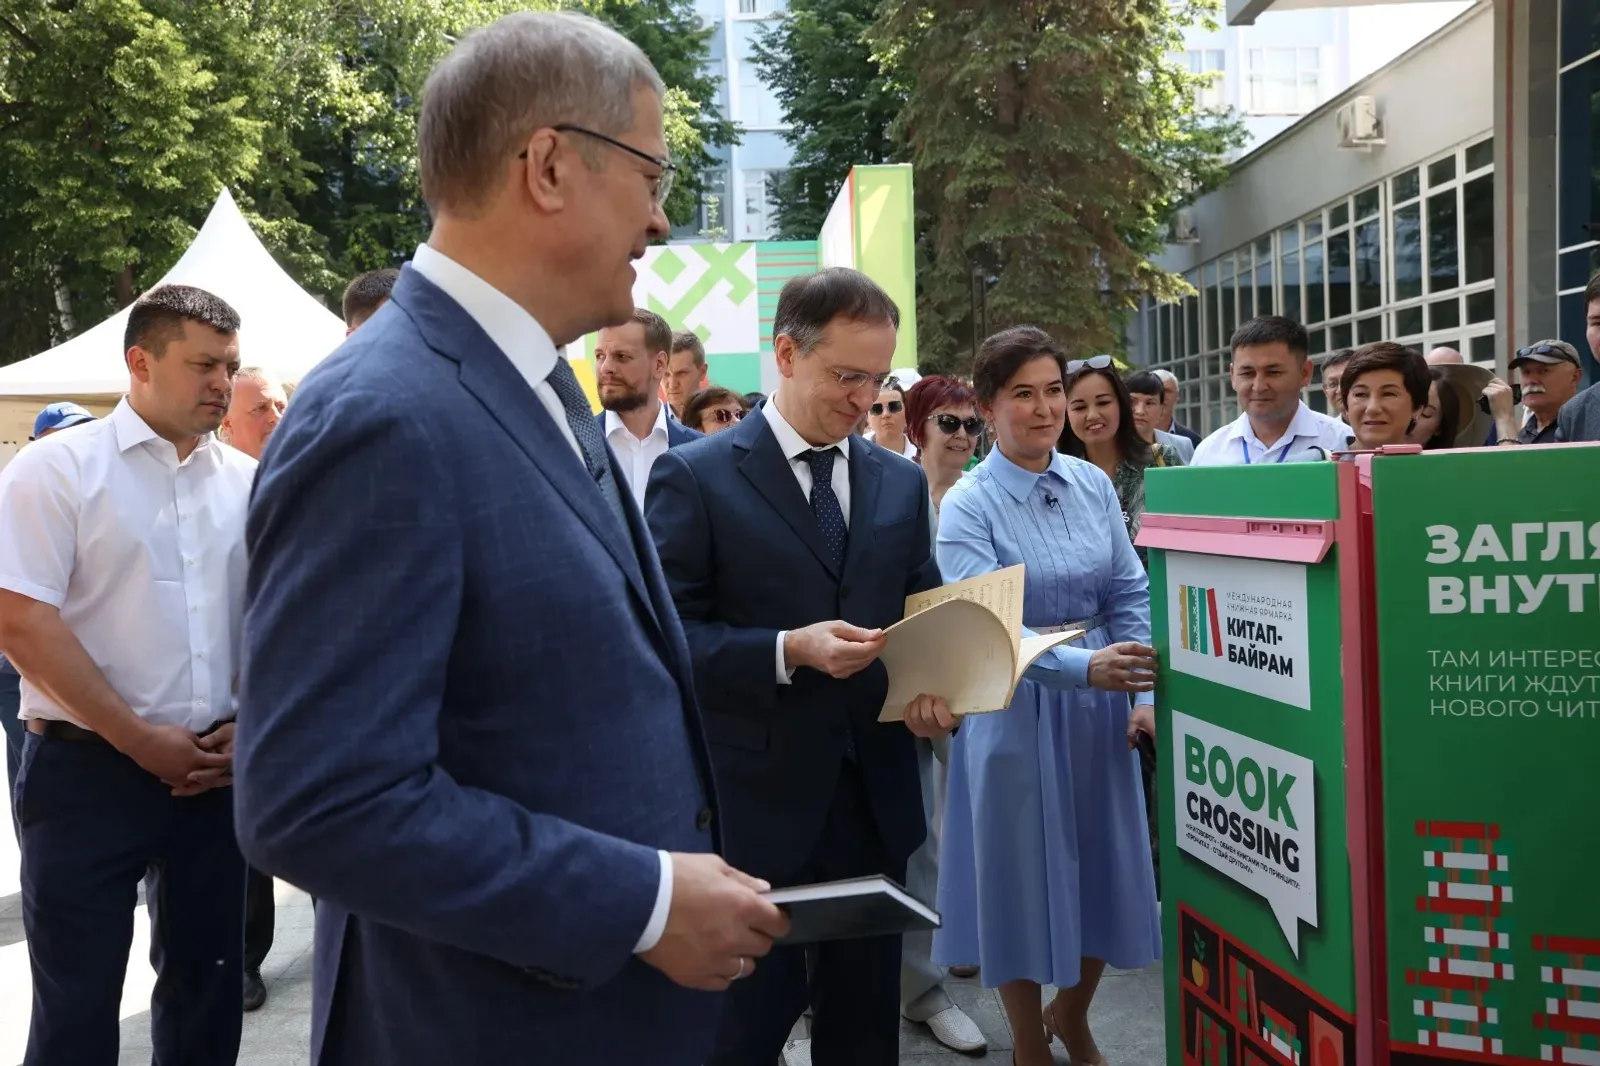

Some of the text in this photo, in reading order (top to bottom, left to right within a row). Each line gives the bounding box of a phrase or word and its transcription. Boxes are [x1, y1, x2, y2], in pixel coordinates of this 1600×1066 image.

[1226, 592, 1293, 609] МЕЖДУНАРОДНАЯ
[1428, 573, 1600, 614] ВНУТ
[1227, 617, 1283, 645] КИТАП-
[1228, 643, 1293, 677] БАЙРАМ
[1427, 650, 1479, 667] ТАМ
[1430, 675, 1600, 696] КНИГИ ЖДУТ
[1430, 699, 1539, 718] НОВОГО
[1185, 733, 1298, 831] BOOK
[1186, 791, 1300, 873] CROSSING
